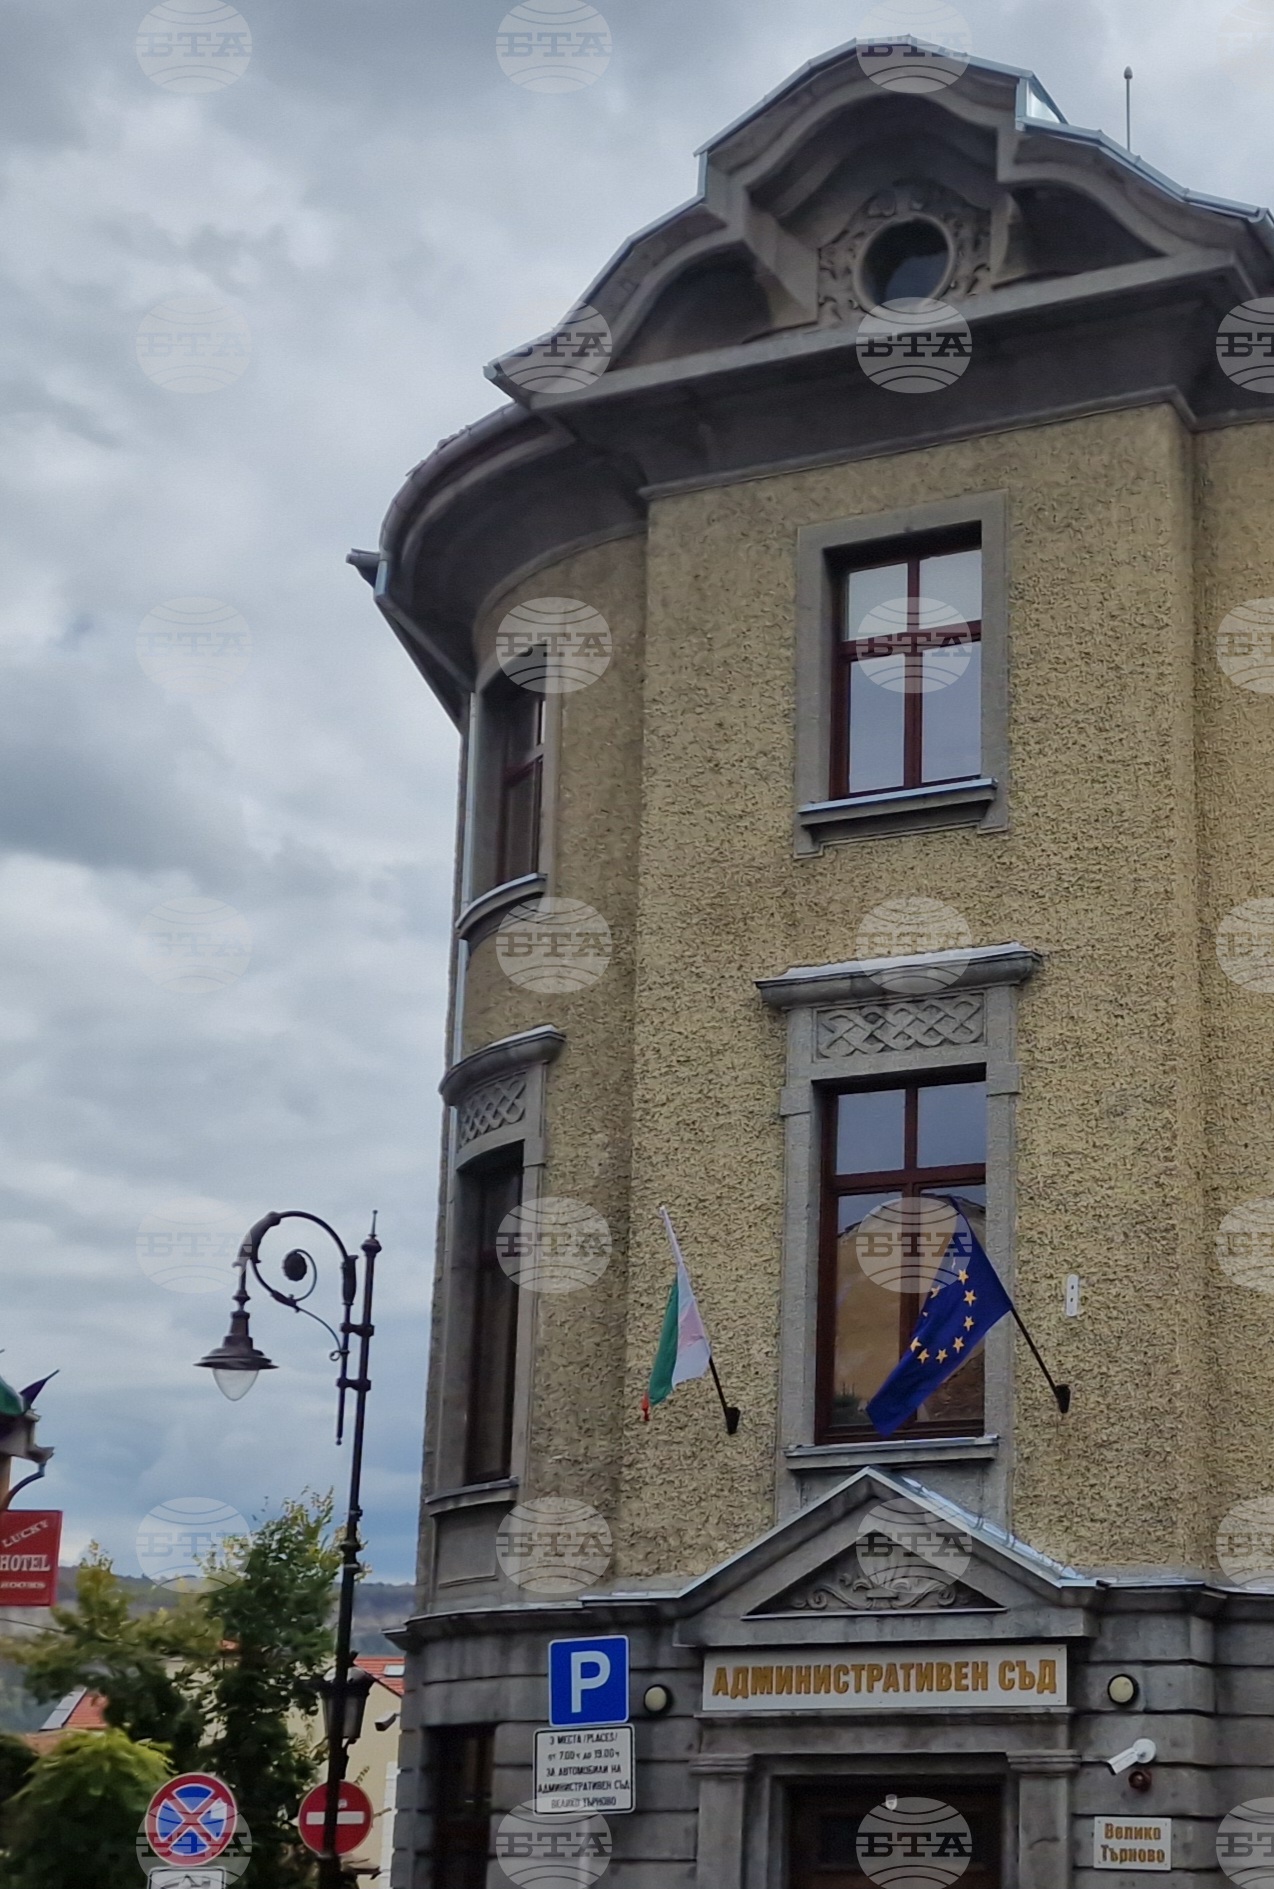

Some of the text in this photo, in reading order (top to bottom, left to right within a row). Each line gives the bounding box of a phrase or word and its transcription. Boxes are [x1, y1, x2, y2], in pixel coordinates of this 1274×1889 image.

[2, 1520, 48, 1548] LUCKY
[0, 1554, 51, 1572] HOTEL
[571, 1650, 611, 1713] P
[712, 1659, 1057, 1699] АДМИНИСТРАТИВЕН СЪД
[557, 1734, 582, 1744] МЕСТА
[546, 1764, 622, 1777] ЗА АВТОМОБИЛИ НА
[537, 1779, 630, 1794] АДМИНИСТРАТИВЕН СЪД
[551, 1797, 581, 1809] ВЕЛИКО
[1104, 1823, 1161, 1840] Велико
[1101, 1844, 1165, 1864] Търново
